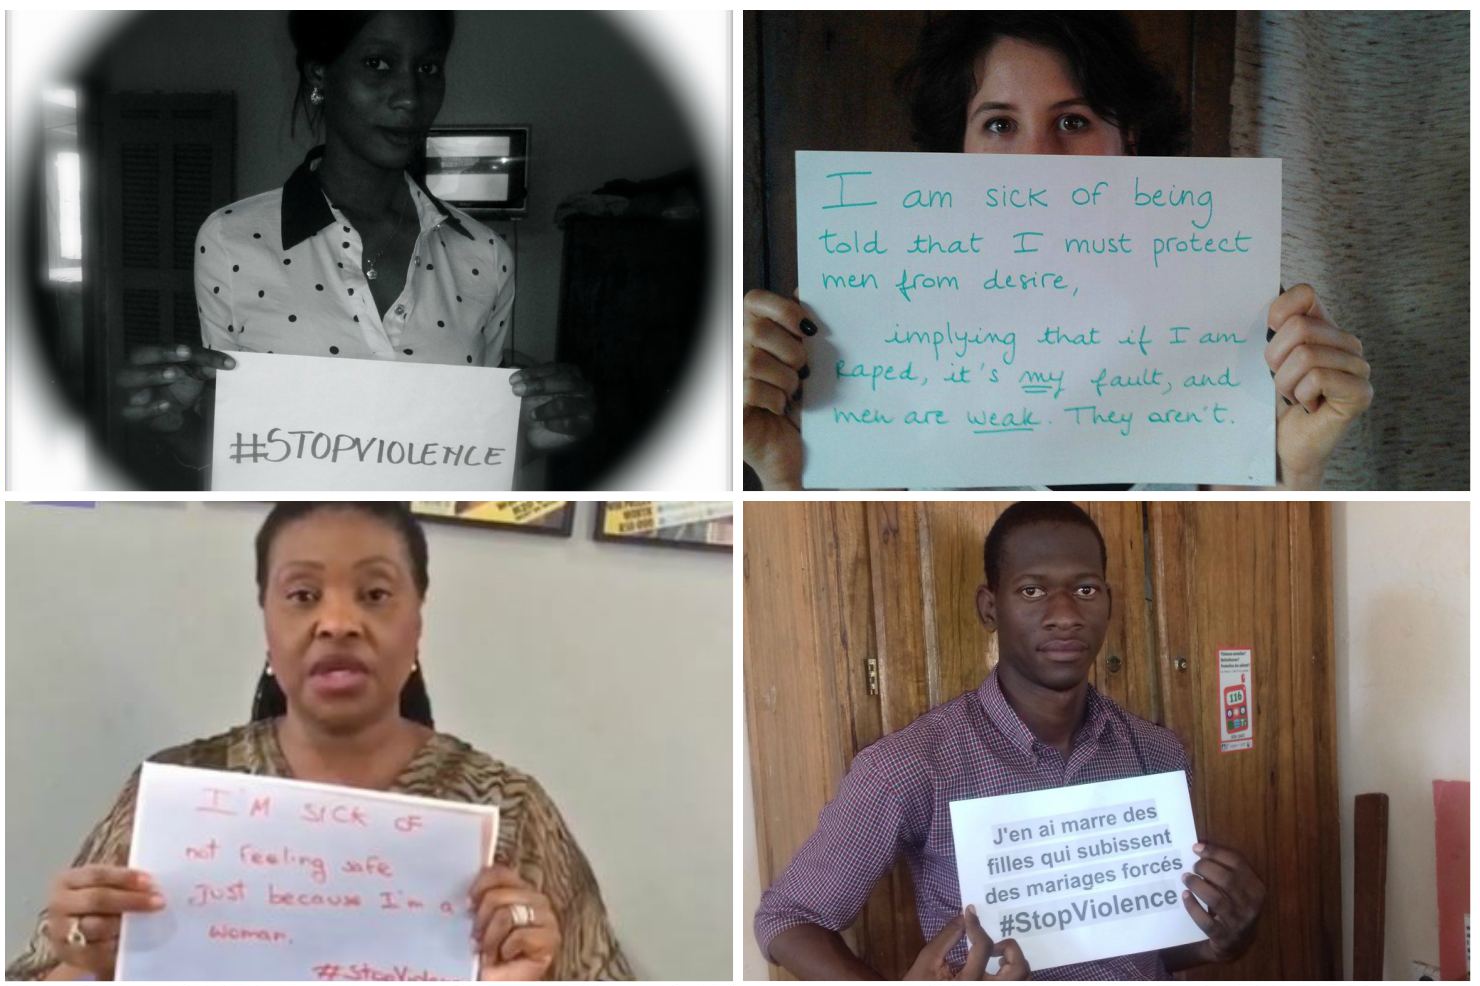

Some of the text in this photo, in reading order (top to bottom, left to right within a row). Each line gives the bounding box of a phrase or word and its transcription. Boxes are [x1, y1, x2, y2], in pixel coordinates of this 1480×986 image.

[822, 171, 1214, 229] I am sick of being
[819, 232, 1252, 267] told that I must protect
[822, 269, 1079, 302] men from desire,
[885, 322, 1246, 365] implying that if I am
[944, 363, 1240, 398] it's my fault, and
[834, 405, 1235, 436] men are They aren't.
[230, 427, 506, 467] #STOPVIOLENCE
[195, 787, 368, 827] I'M SICK
[993, 805, 1157, 845] J'en ai marre des
[185, 840, 218, 860] not
[987, 829, 1172, 875] filles qui subissent
[268, 888, 455, 913] because I'm a
[985, 856, 1183, 905] des mariages forcés
[1000, 889, 1178, 937] #StopViolence
